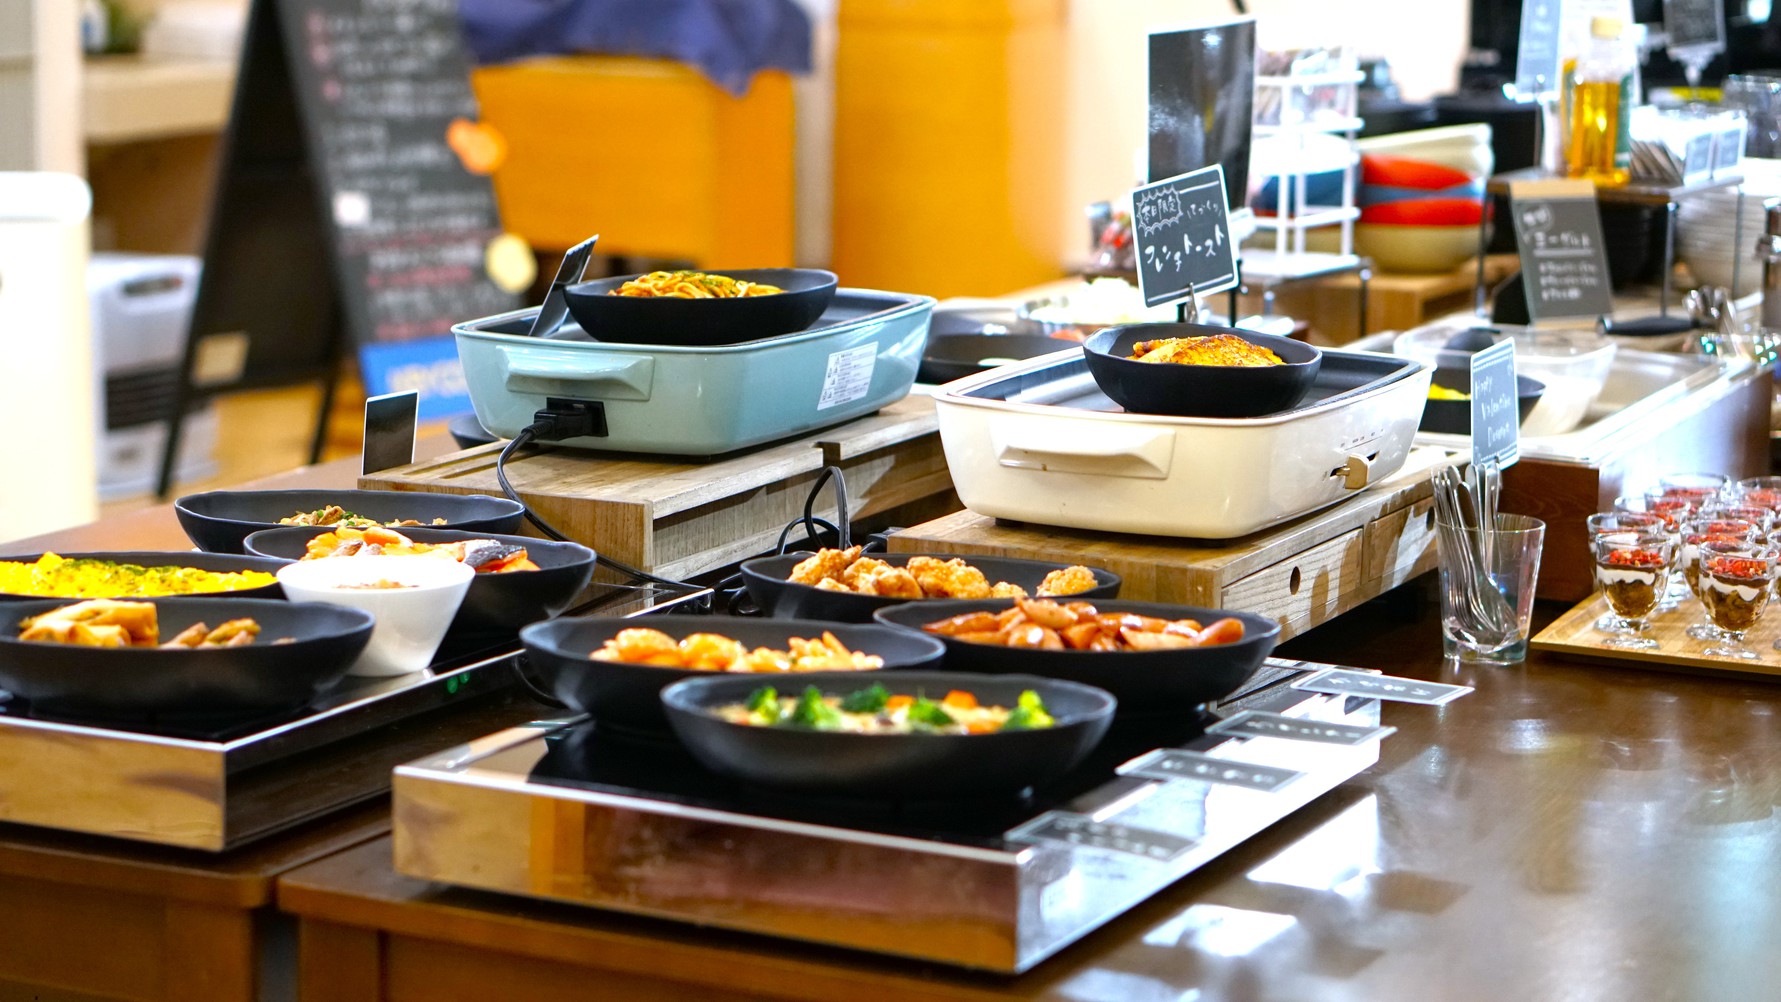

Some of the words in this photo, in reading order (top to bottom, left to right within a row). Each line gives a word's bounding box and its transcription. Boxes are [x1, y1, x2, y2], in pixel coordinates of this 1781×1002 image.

[1144, 224, 1224, 272] フレンチトースト
